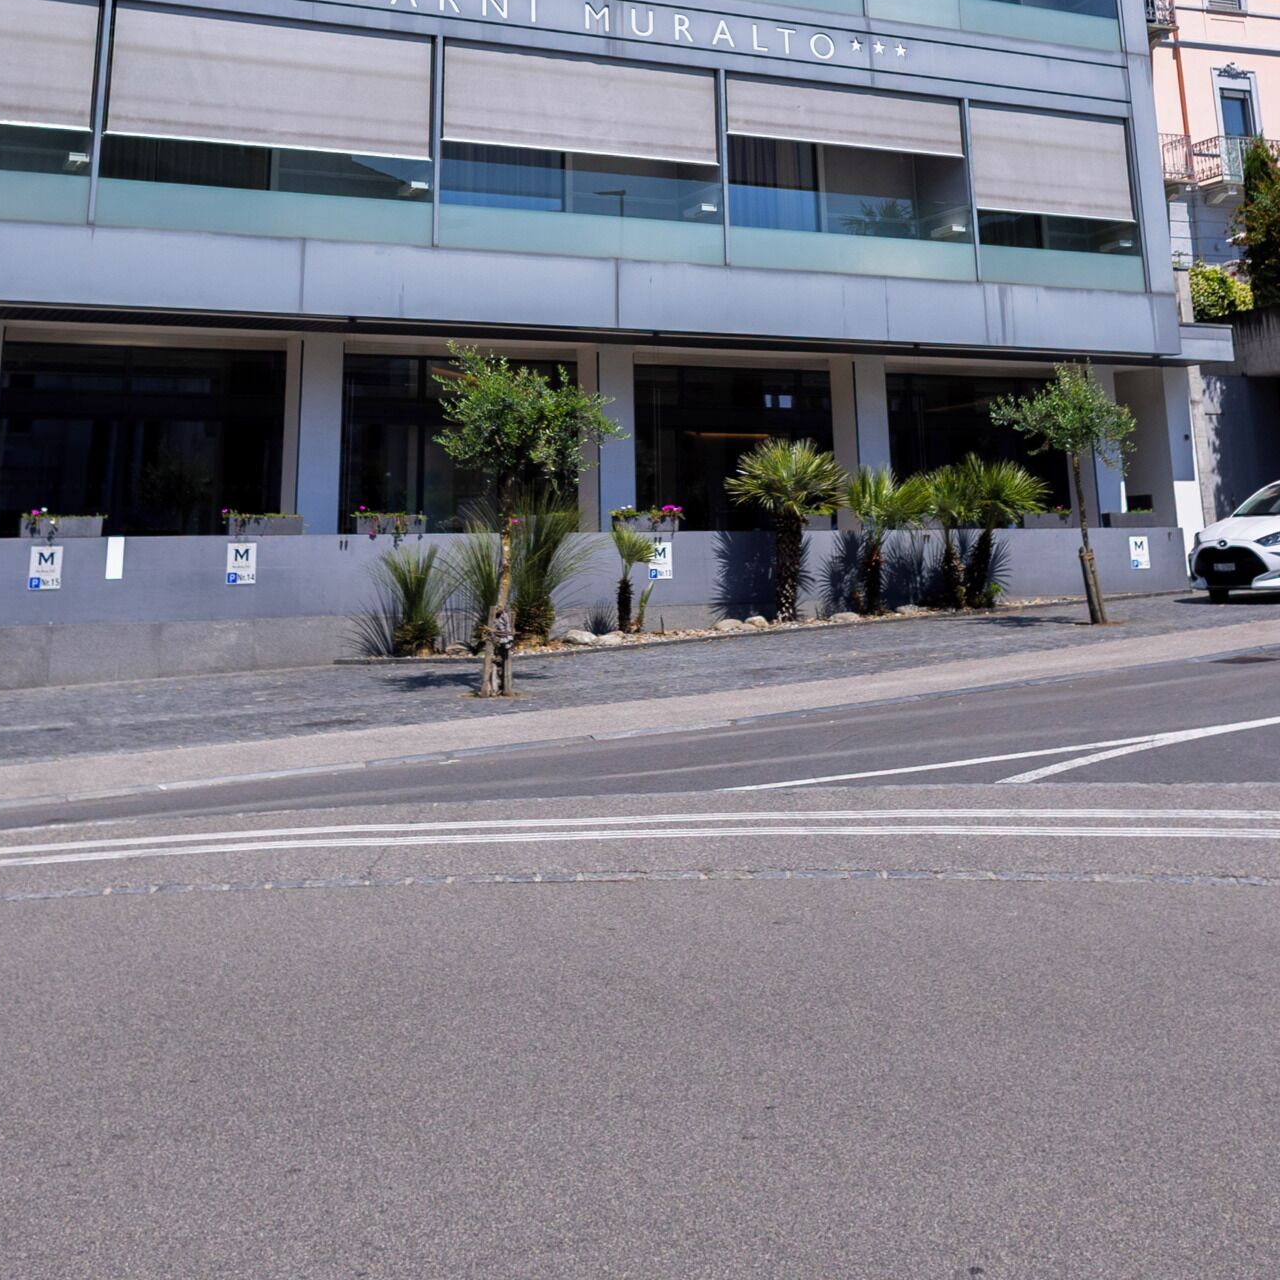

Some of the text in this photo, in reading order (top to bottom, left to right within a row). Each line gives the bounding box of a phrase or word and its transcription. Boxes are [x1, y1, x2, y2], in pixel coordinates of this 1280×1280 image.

[584, 2, 836, 60] MURALTO
[38, 552, 55, 566] M
[234, 549, 250, 561] M
